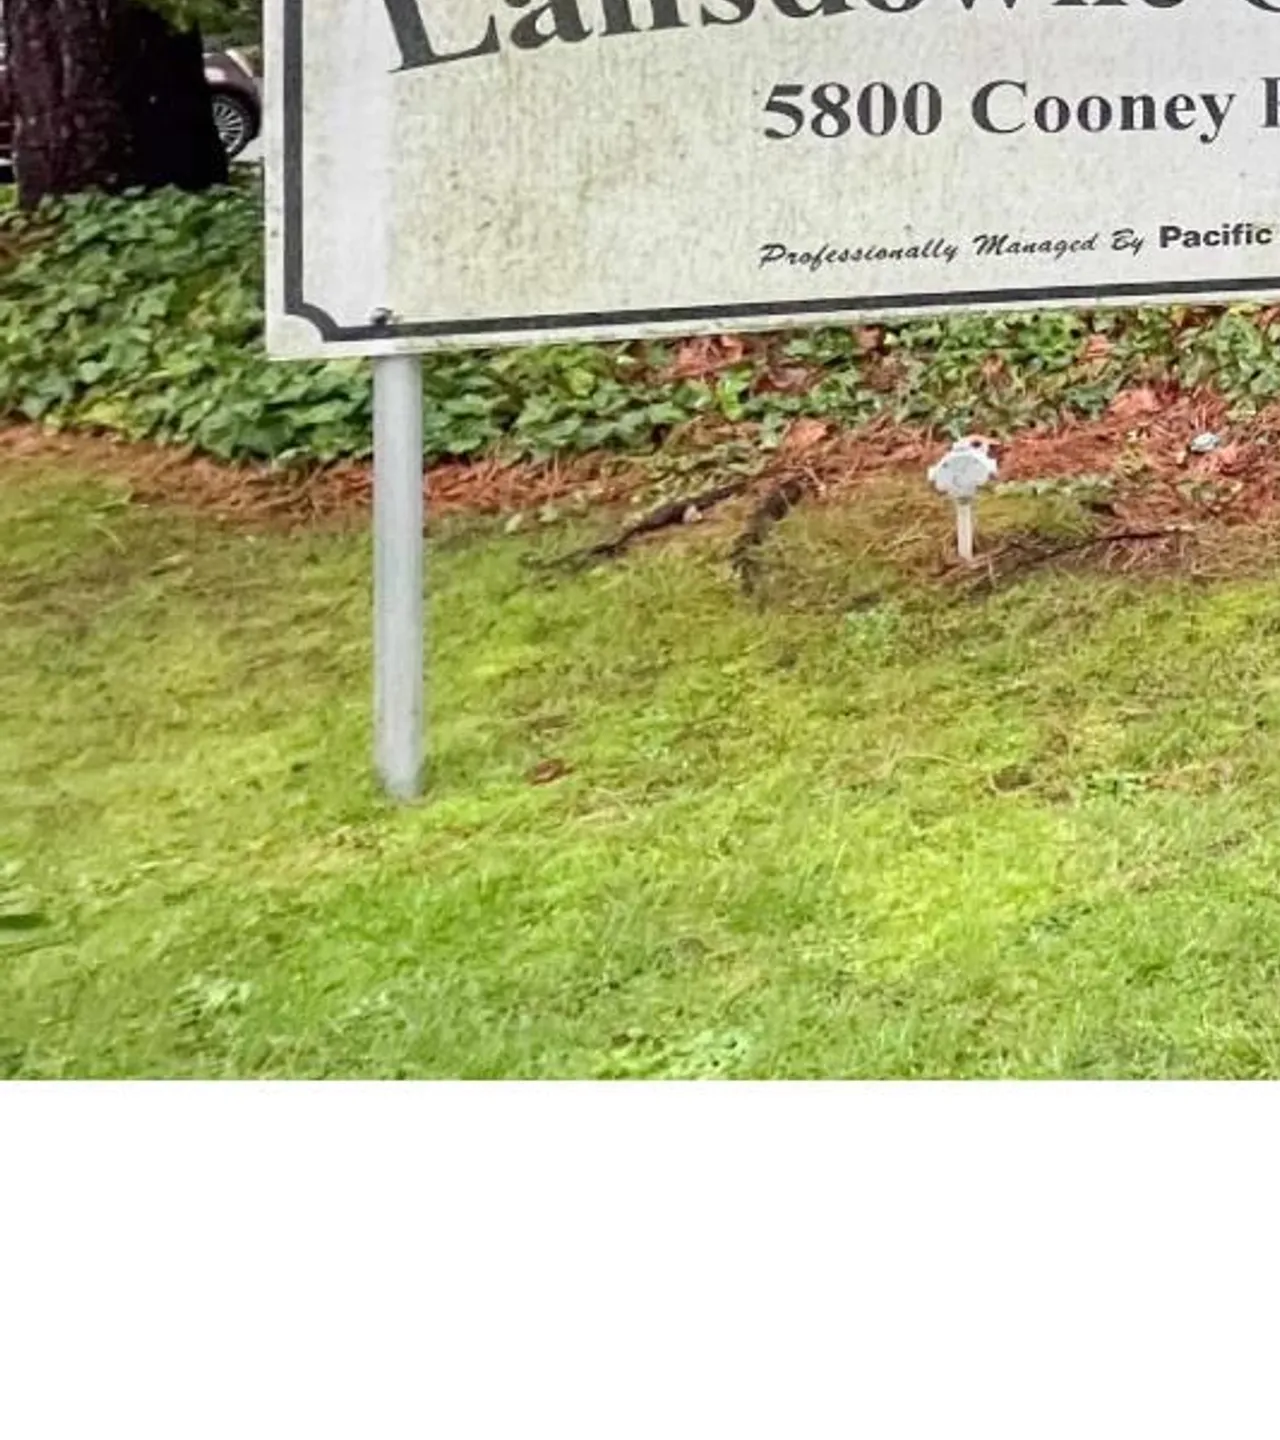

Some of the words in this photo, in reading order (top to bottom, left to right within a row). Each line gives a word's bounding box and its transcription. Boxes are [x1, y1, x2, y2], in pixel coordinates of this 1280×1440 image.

[763, 81, 943, 140] 5800
[970, 77, 1236, 144] Cooney
[758, 238, 959, 270] Professionally
[971, 232, 1099, 258] Managed
[1109, 227, 1145, 255] By
[1159, 222, 1274, 248] Pacific
